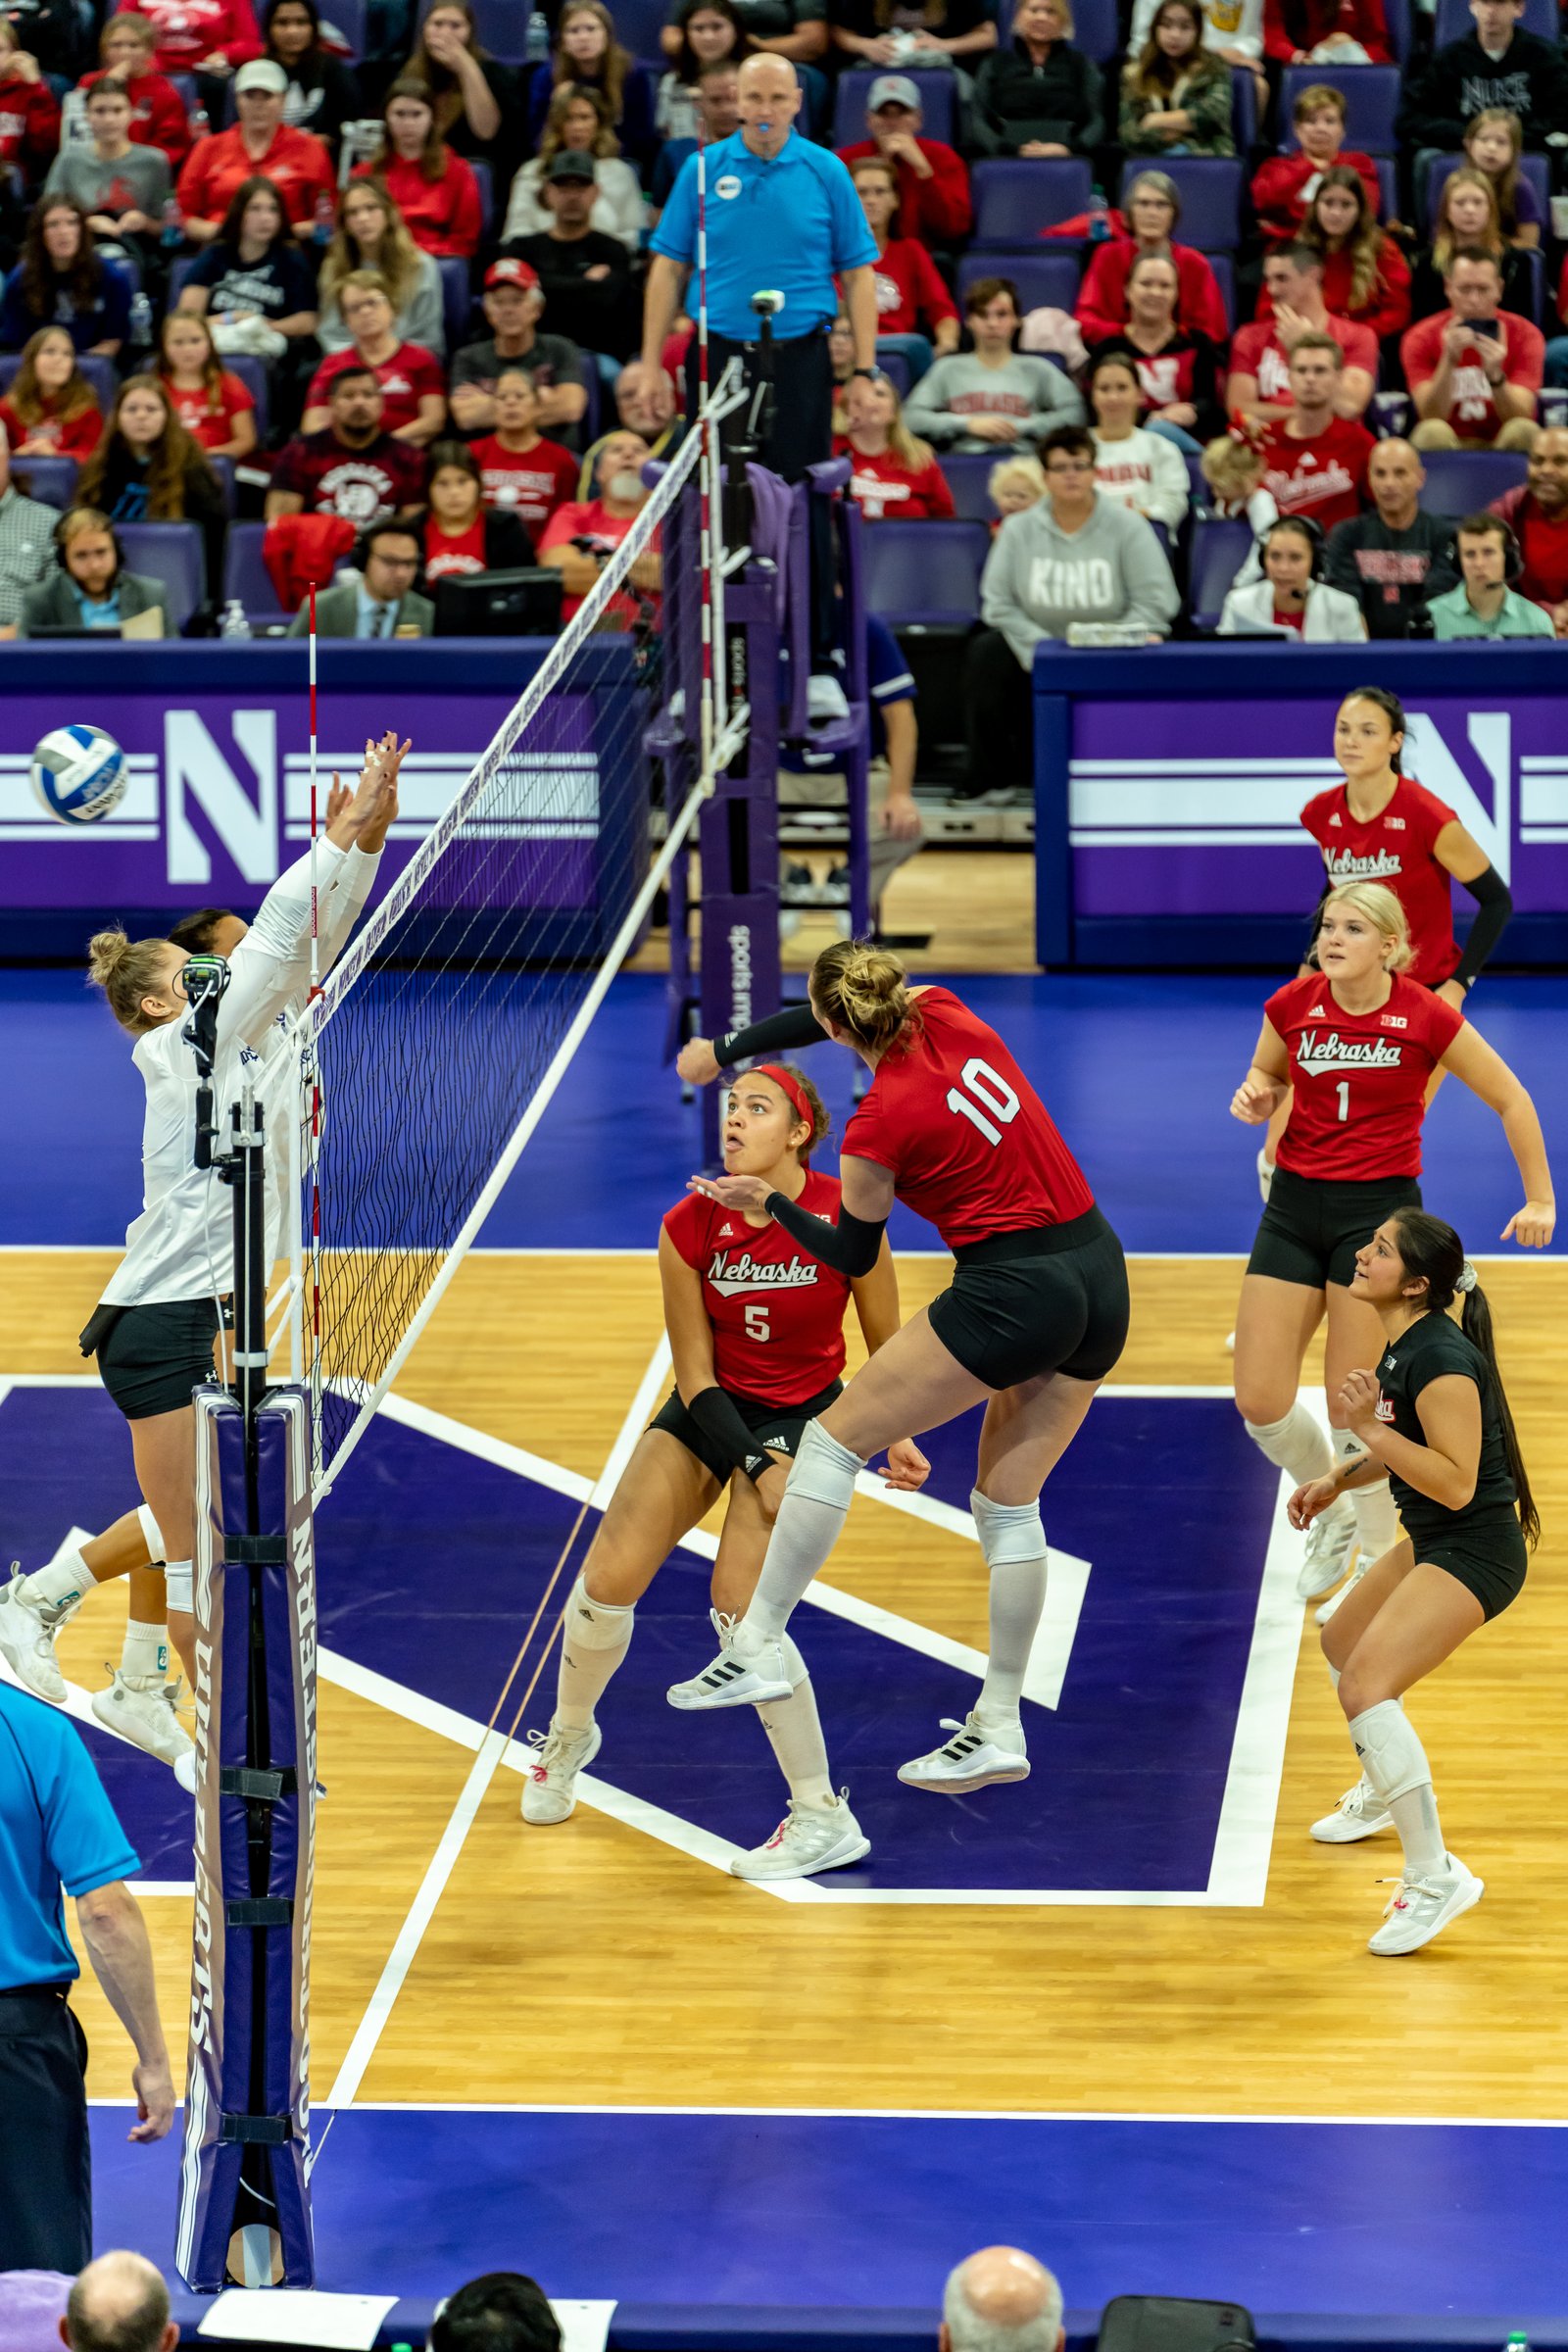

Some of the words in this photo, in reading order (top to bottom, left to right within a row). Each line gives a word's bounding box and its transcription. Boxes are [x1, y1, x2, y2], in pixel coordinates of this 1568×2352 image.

[1029, 558, 1114, 610] KIND
[165, 710, 279, 884] N
[1324, 846, 1403, 875] Nebraska
[728, 925, 754, 992] sports
[1297, 1029, 1402, 1063] Nebraska
[945, 1056, 1022, 1148] 10
[1336, 1081, 1350, 1122] 1
[708, 1250, 819, 1283] Nebraska
[743, 1304, 771, 1344] 5
